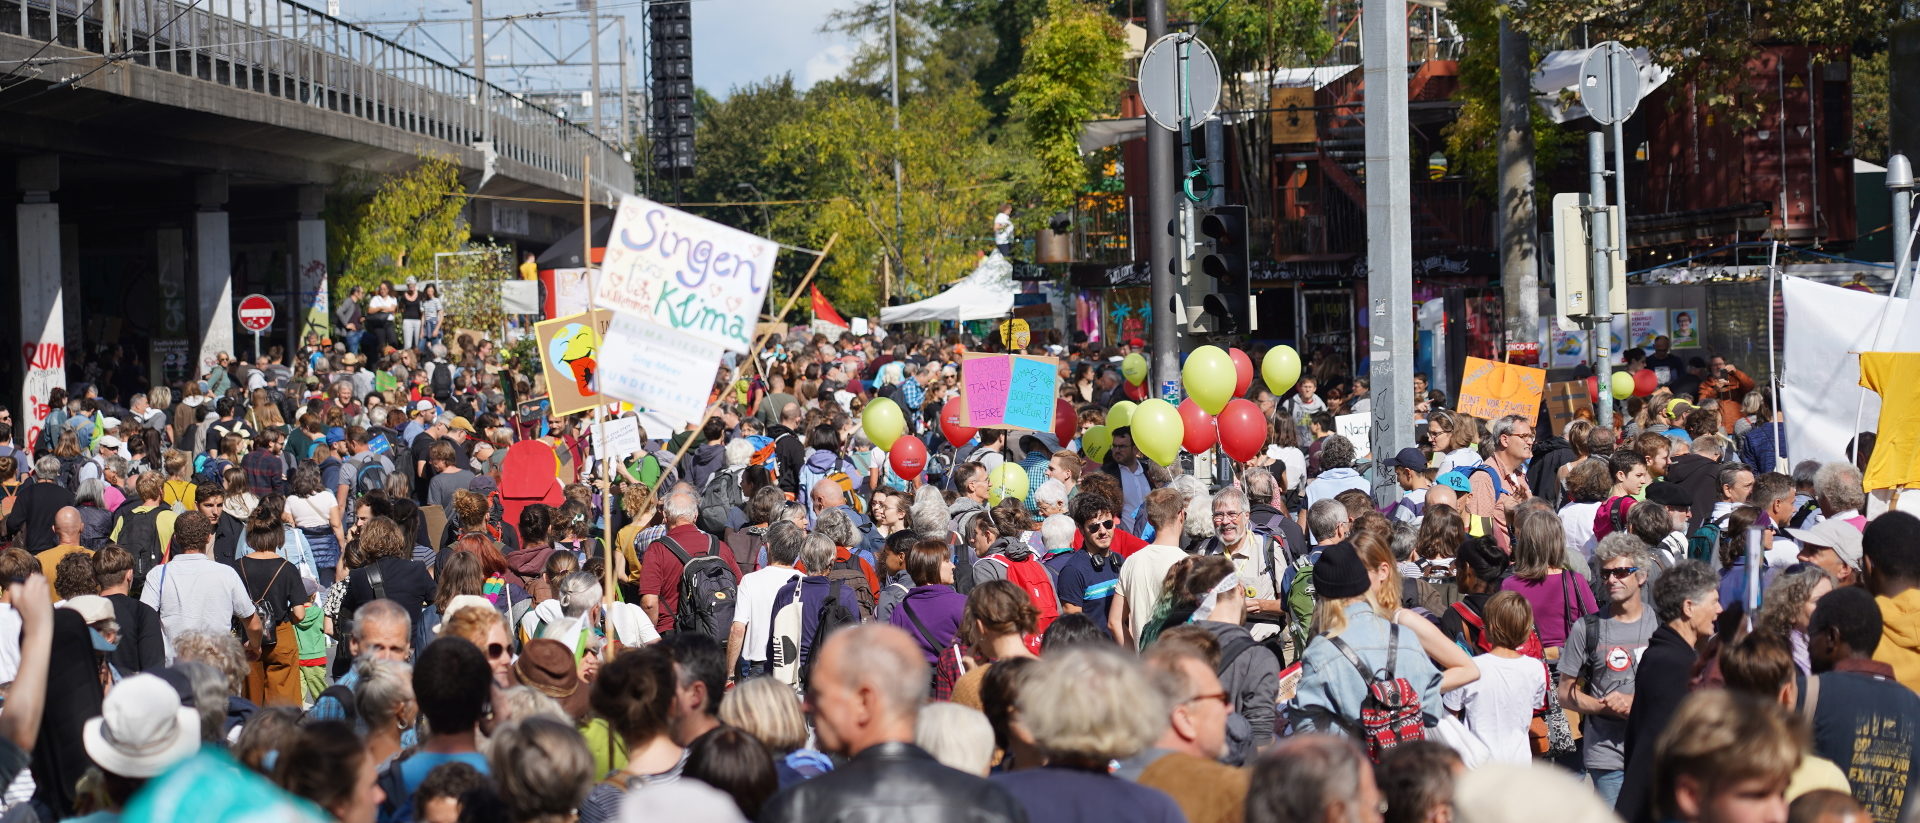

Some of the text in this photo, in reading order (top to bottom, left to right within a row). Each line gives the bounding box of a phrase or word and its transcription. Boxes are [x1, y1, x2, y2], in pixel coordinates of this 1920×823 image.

[621, 209, 760, 294] Singen
[654, 280, 750, 344] Klima
[969, 380, 1008, 394] TAIRE
[1486, 398, 1500, 408] VOR
[972, 407, 1003, 420] TERRE
